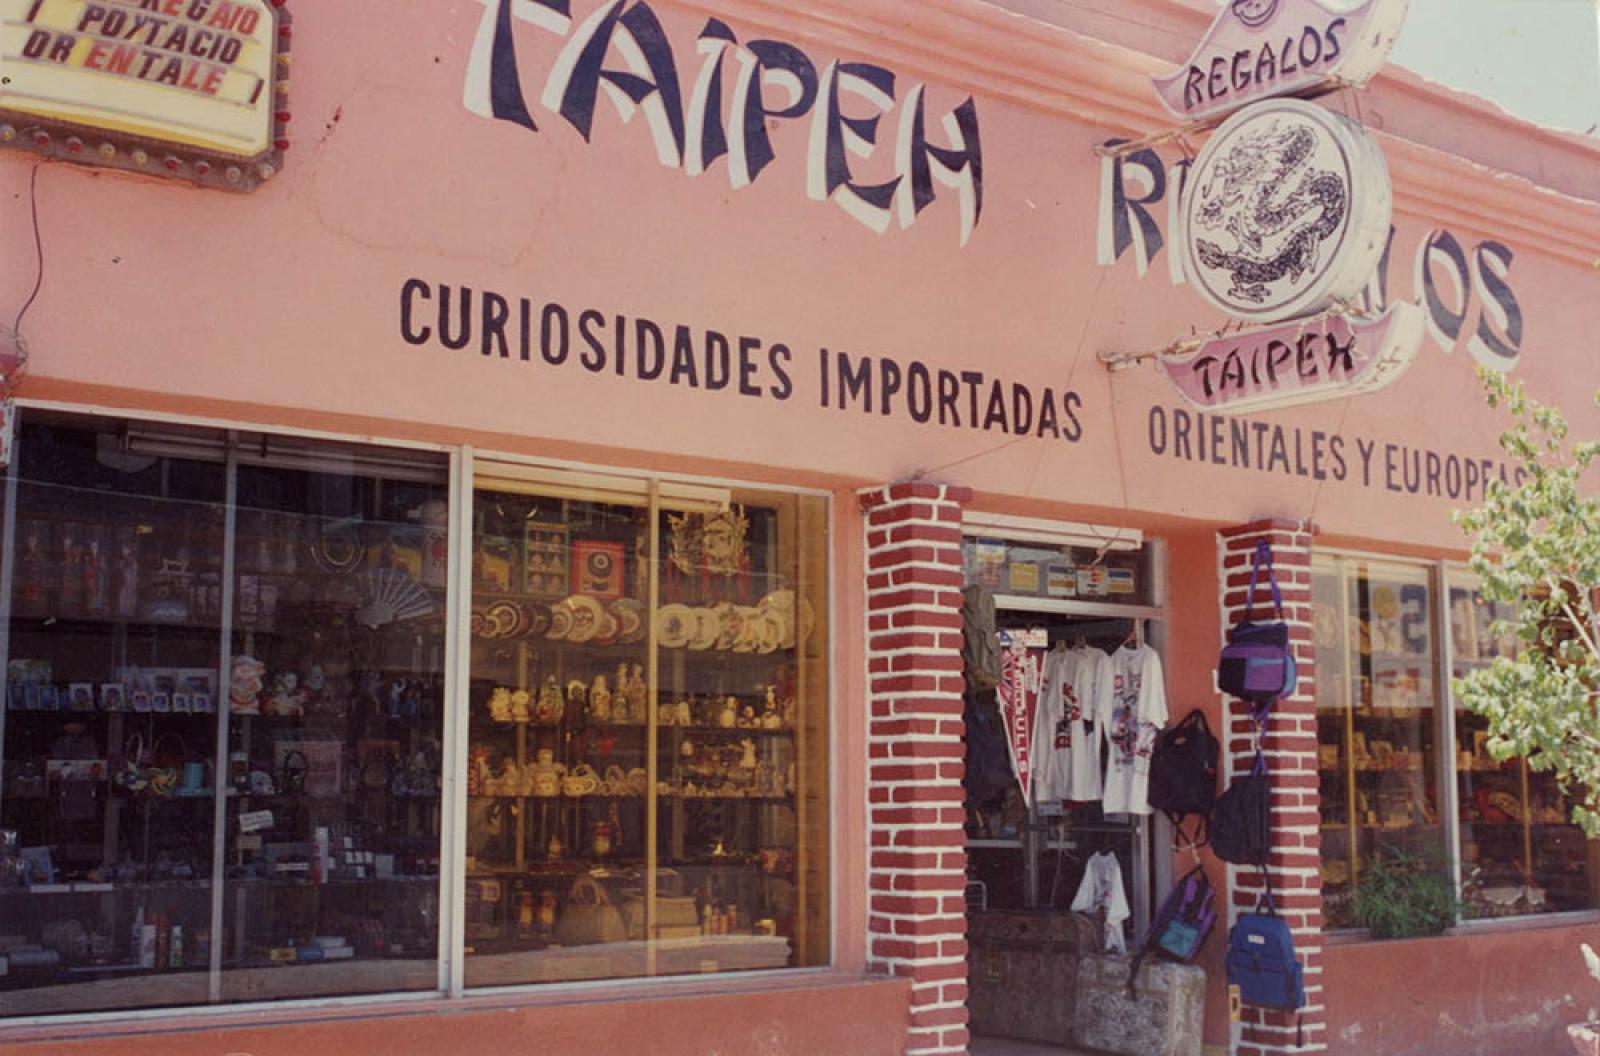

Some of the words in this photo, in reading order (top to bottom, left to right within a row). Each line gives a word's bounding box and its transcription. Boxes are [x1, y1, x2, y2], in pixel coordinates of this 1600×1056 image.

[463, 0, 984, 248] TAIPEH
[1184, 18, 1346, 109] REGALOS
[400, 278, 793, 401] CURIOSIDADES
[820, 348, 1083, 443] IMPORTADAS
[1149, 405, 1348, 481] ORIENTALES
[1356, 437, 1375, 487] Y
[1192, 332, 1355, 398] TAIPEH
